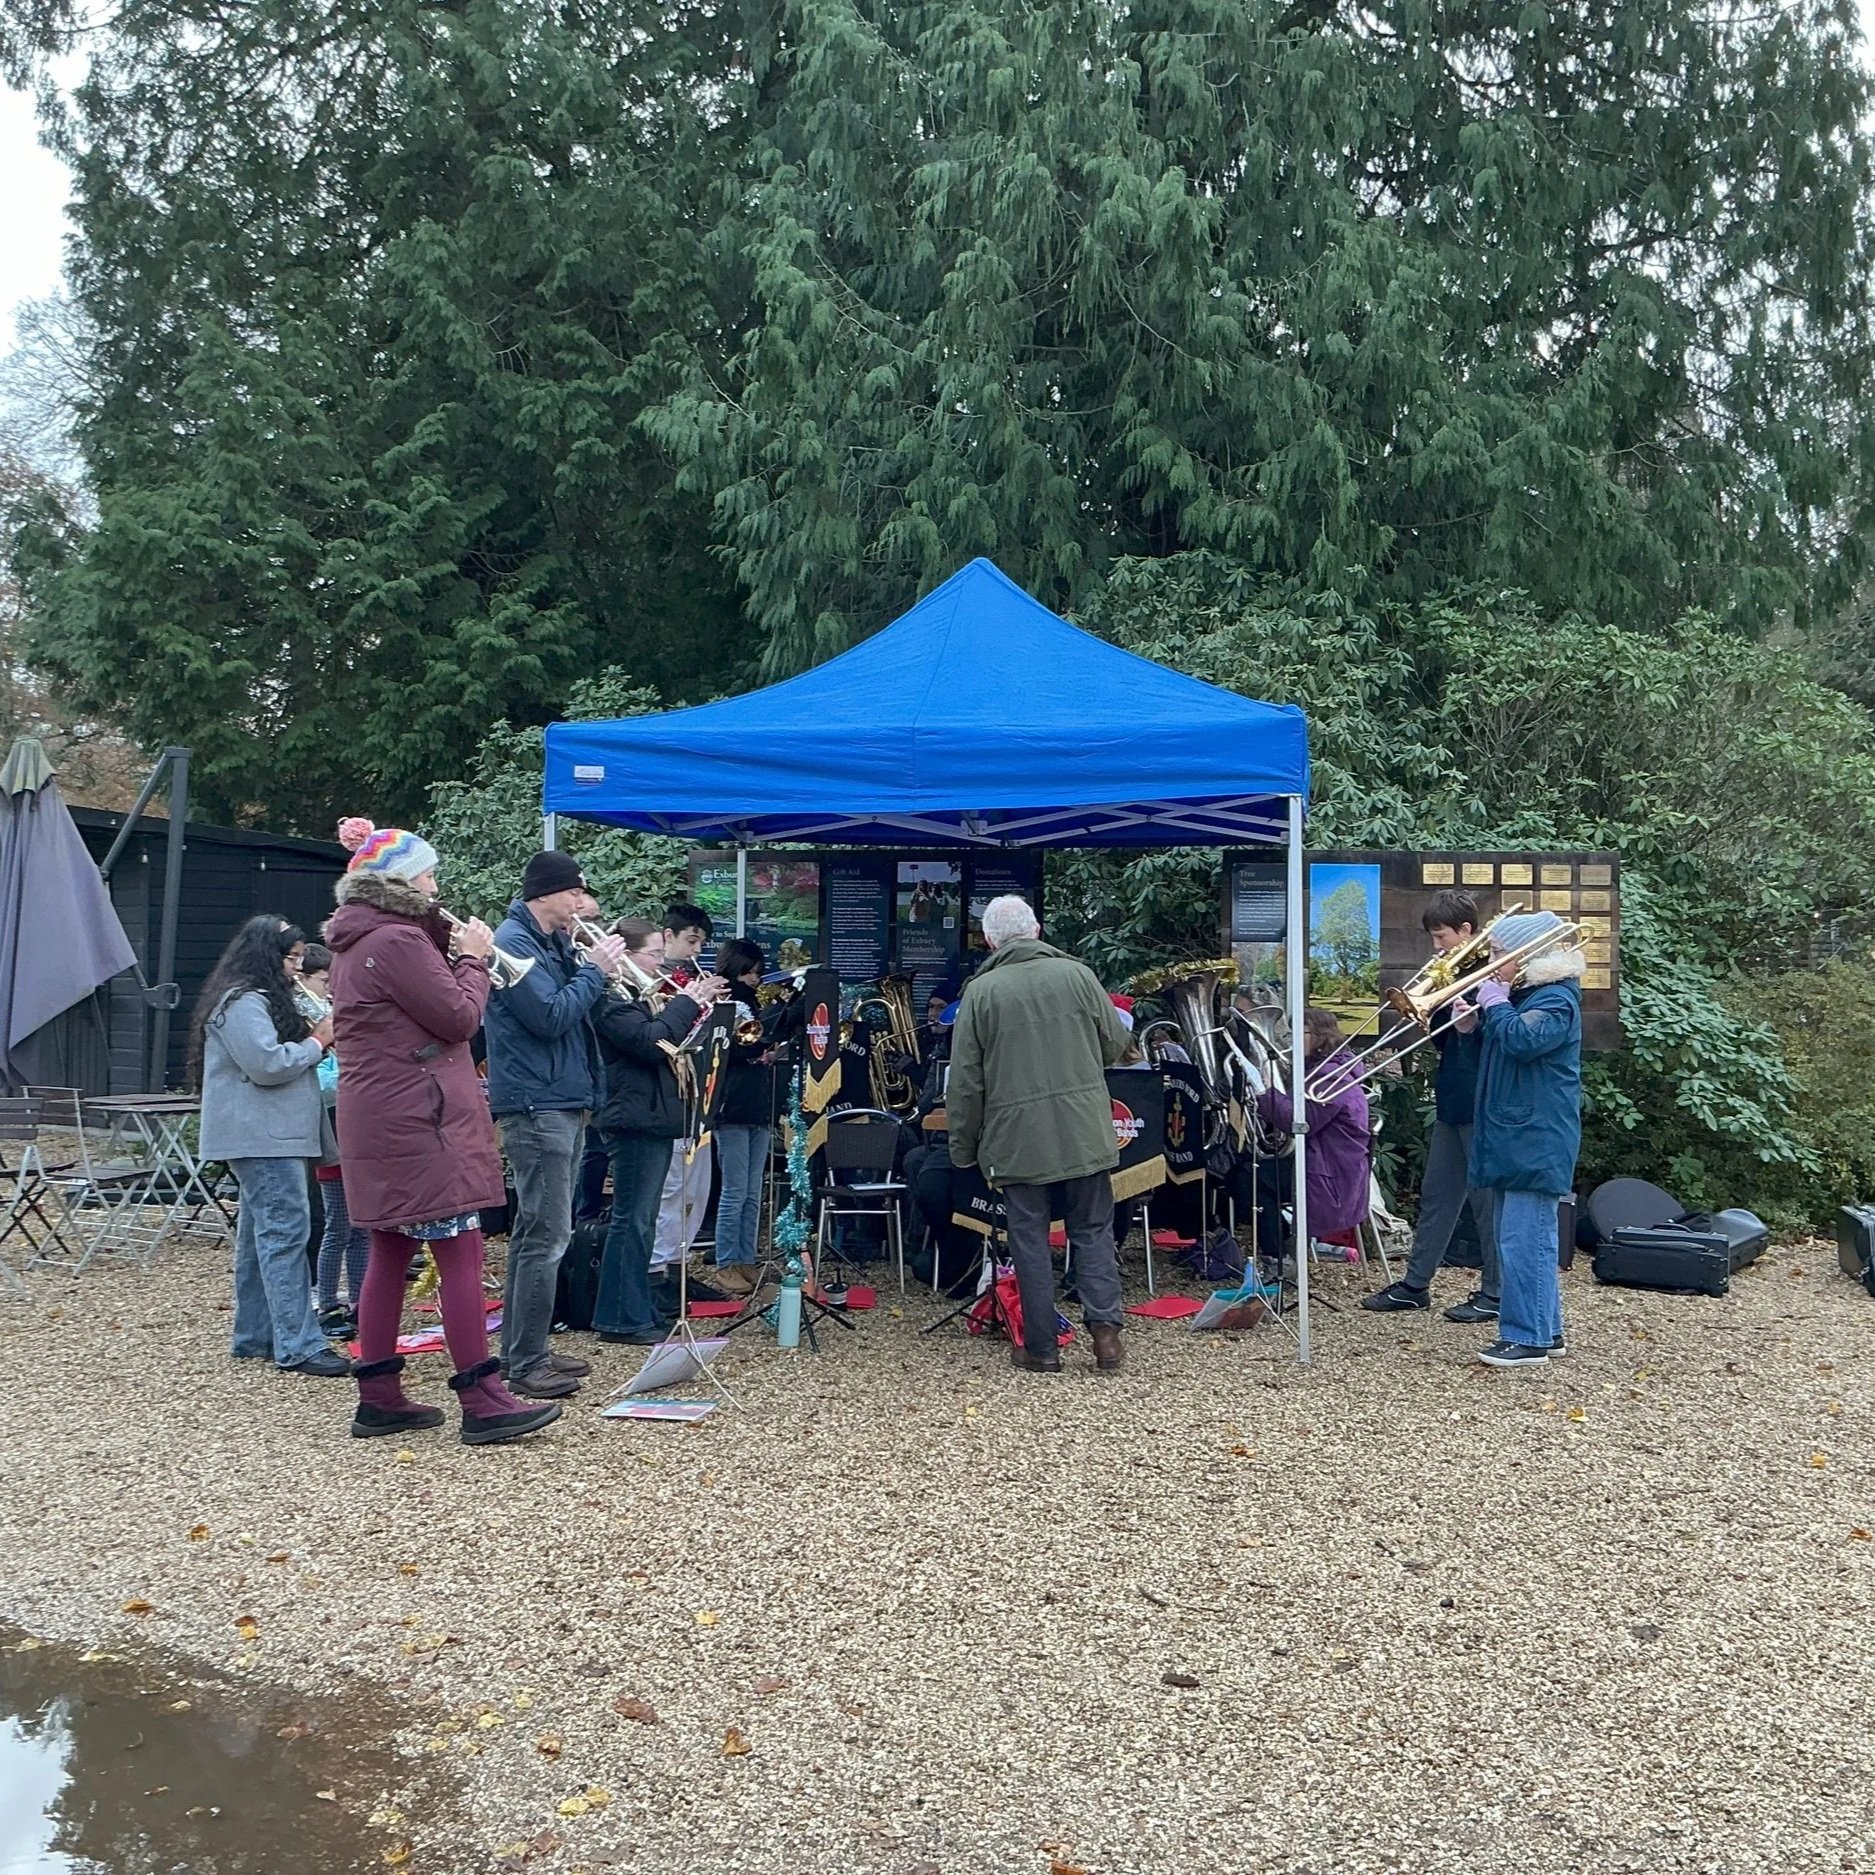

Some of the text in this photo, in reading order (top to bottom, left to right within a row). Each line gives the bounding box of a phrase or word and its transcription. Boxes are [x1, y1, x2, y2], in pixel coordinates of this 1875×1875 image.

[713, 868, 739, 879] Exbur
[1239, 870, 1257, 878] Tree
[1239, 878, 1285, 889] Sponsorship
[902, 928, 929, 936] Friends
